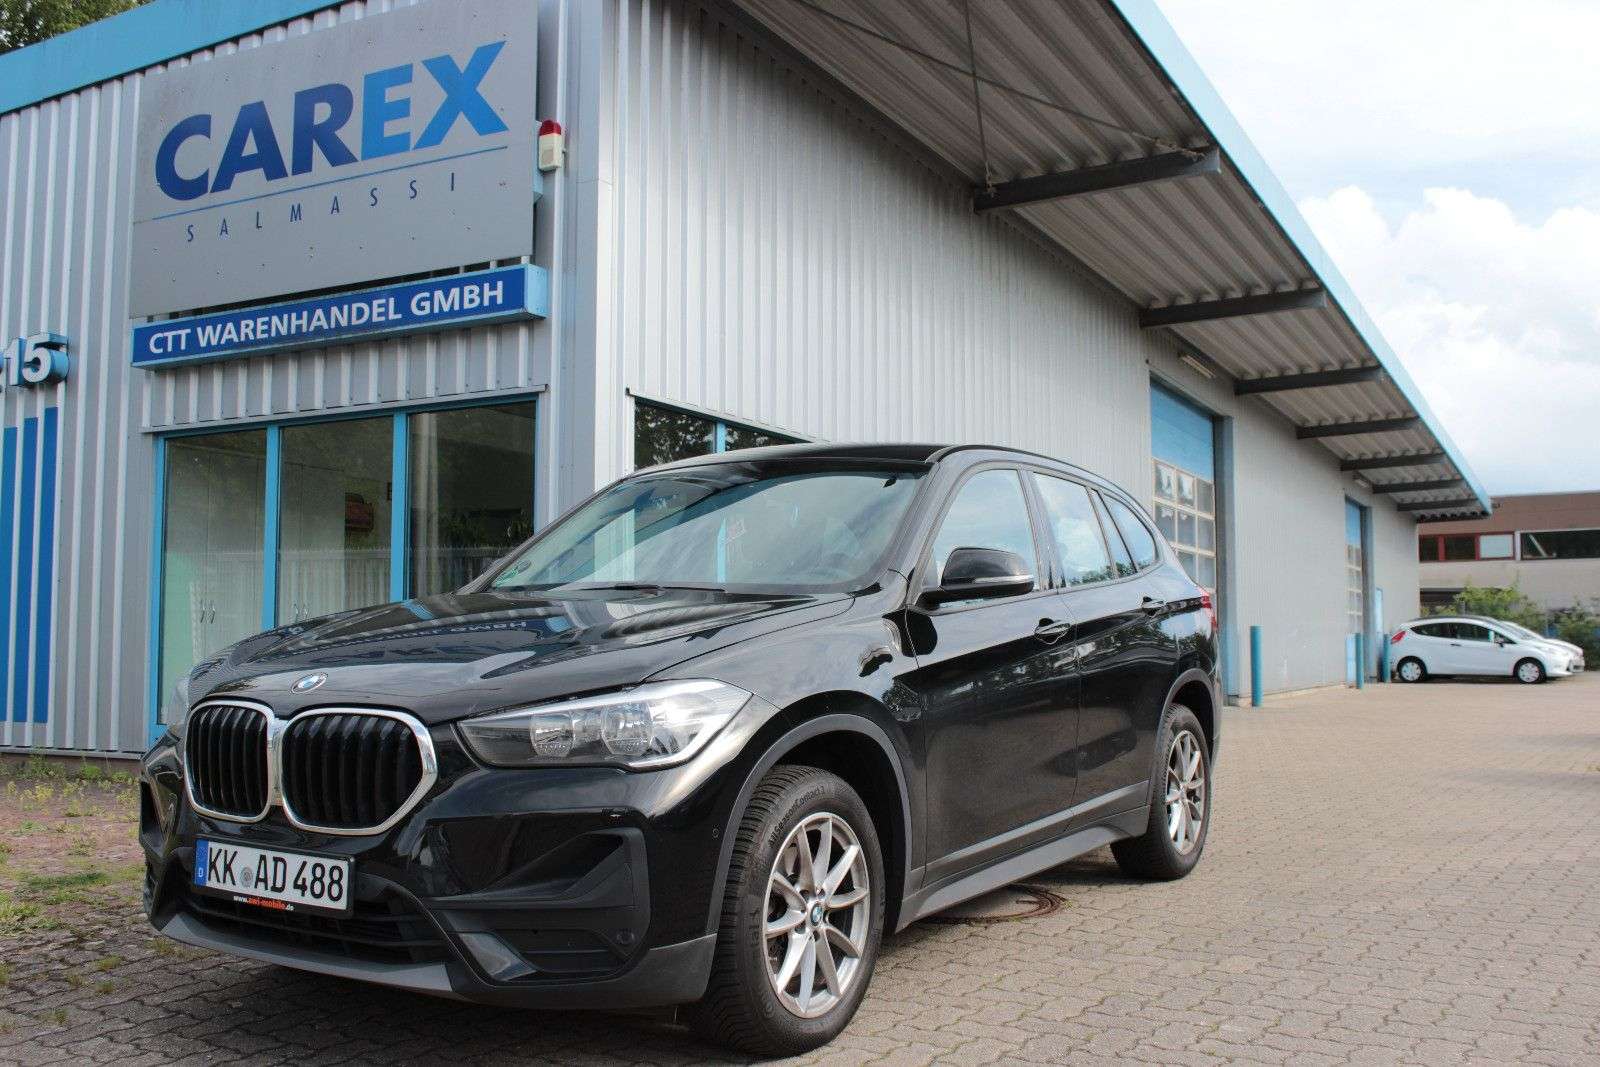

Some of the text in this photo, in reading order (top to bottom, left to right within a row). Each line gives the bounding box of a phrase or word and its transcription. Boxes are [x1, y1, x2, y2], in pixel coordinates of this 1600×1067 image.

[155, 40, 509, 201] CAREX
[187, 172, 455, 242] SALMASSI
[148, 280, 504, 354] CTT WARENHANDEL GMBH
[207, 847, 344, 902] KK AD 488
